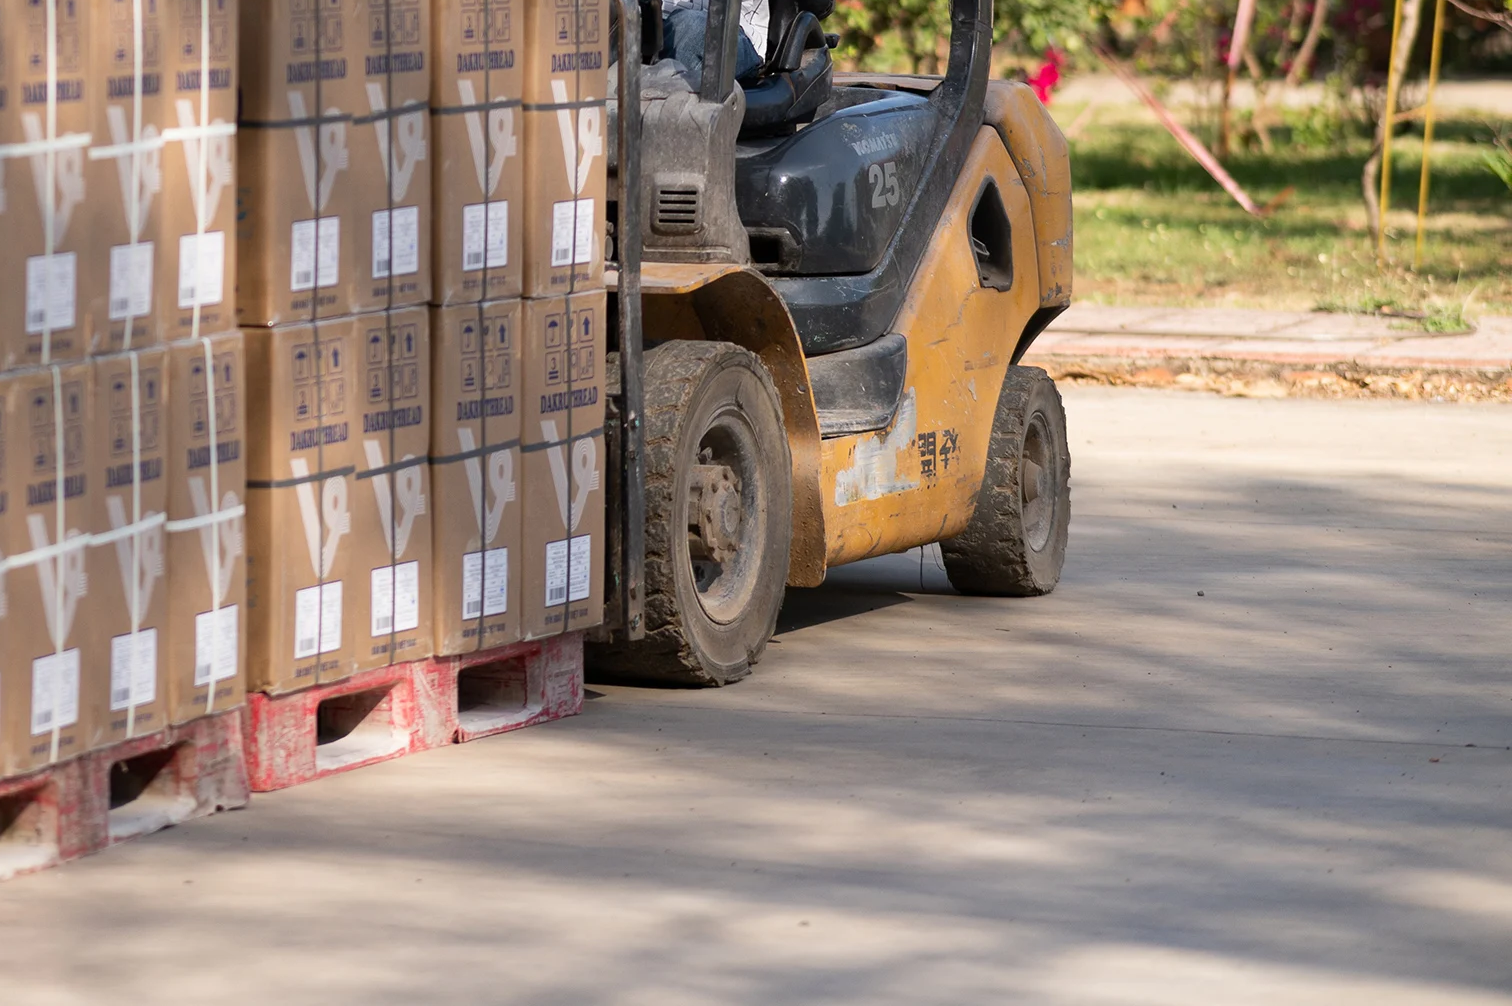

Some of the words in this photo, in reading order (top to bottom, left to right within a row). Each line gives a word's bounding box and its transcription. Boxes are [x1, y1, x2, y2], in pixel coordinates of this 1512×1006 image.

[457, 49, 514, 73] DAKRUHREAD
[551, 51, 602, 73] DAKRUHREAD
[851, 131, 898, 156] KOMATSU
[869, 161, 900, 209] 25
